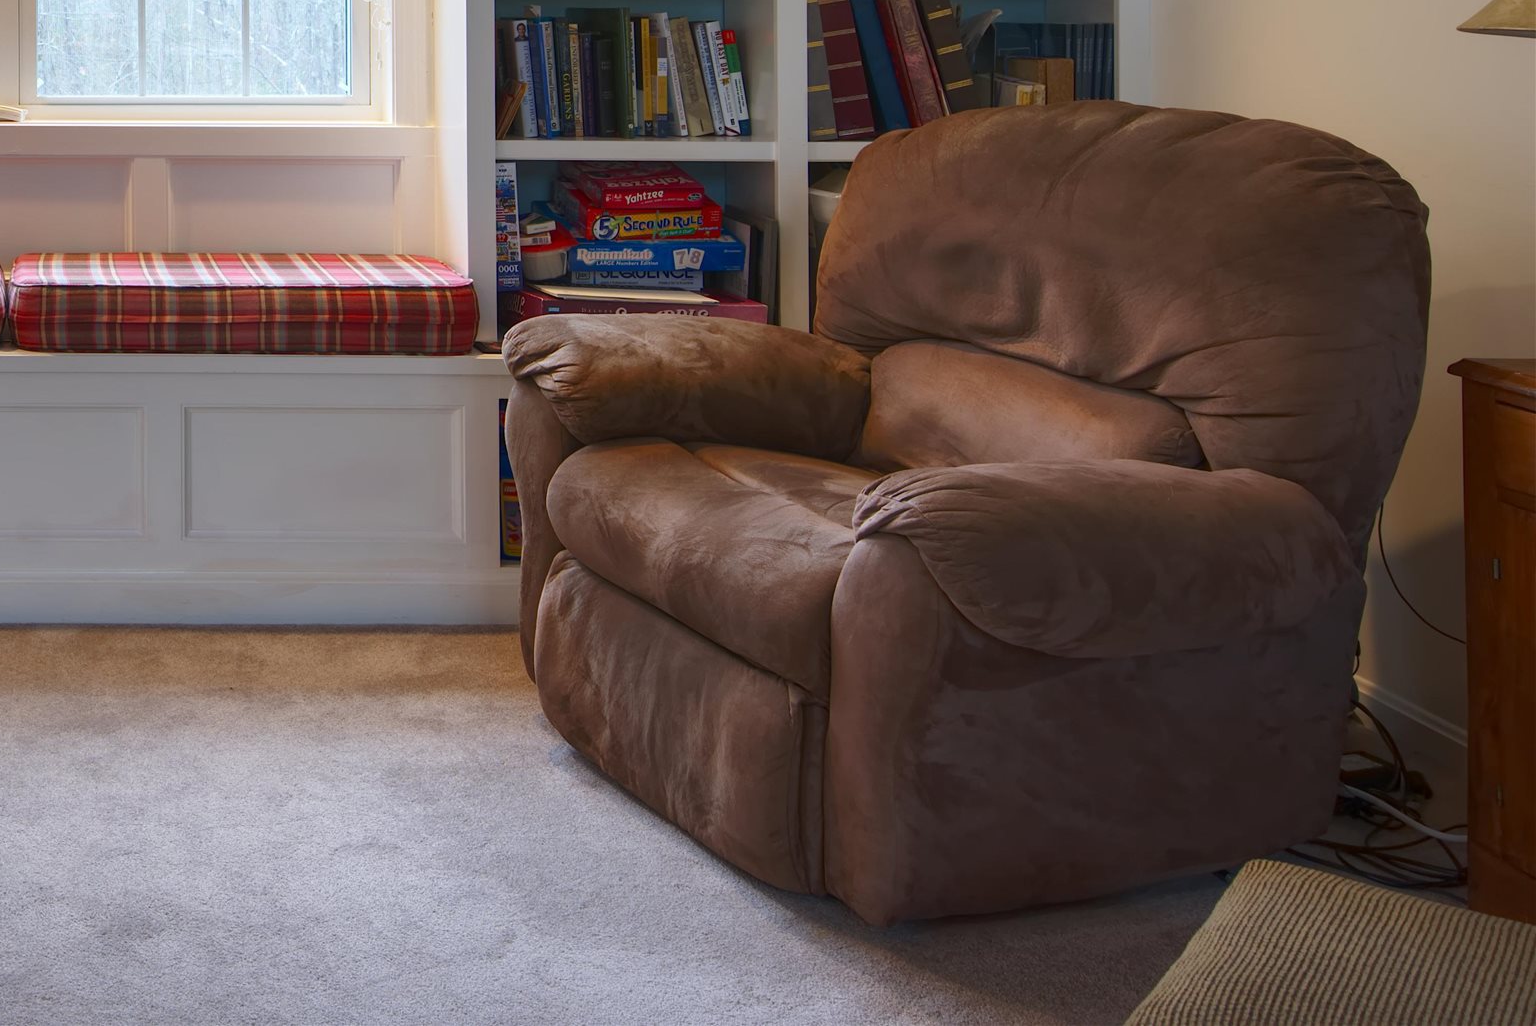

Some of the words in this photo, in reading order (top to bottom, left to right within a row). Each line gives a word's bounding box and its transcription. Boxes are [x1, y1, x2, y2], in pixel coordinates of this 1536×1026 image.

[715, 30, 723, 41] NO
[718, 43, 726, 60] EASY
[721, 63, 729, 77] DAY
[563, 73, 573, 120] GARDENS
[624, 190, 665, 205] Yahtzee
[599, 218, 613, 239] 5
[623, 216, 671, 232] SECOND
[673, 215, 704, 229] RULE
[676, 251, 686, 265] 7
[691, 250, 701, 264] 8
[498, 264, 519, 273] 1000
